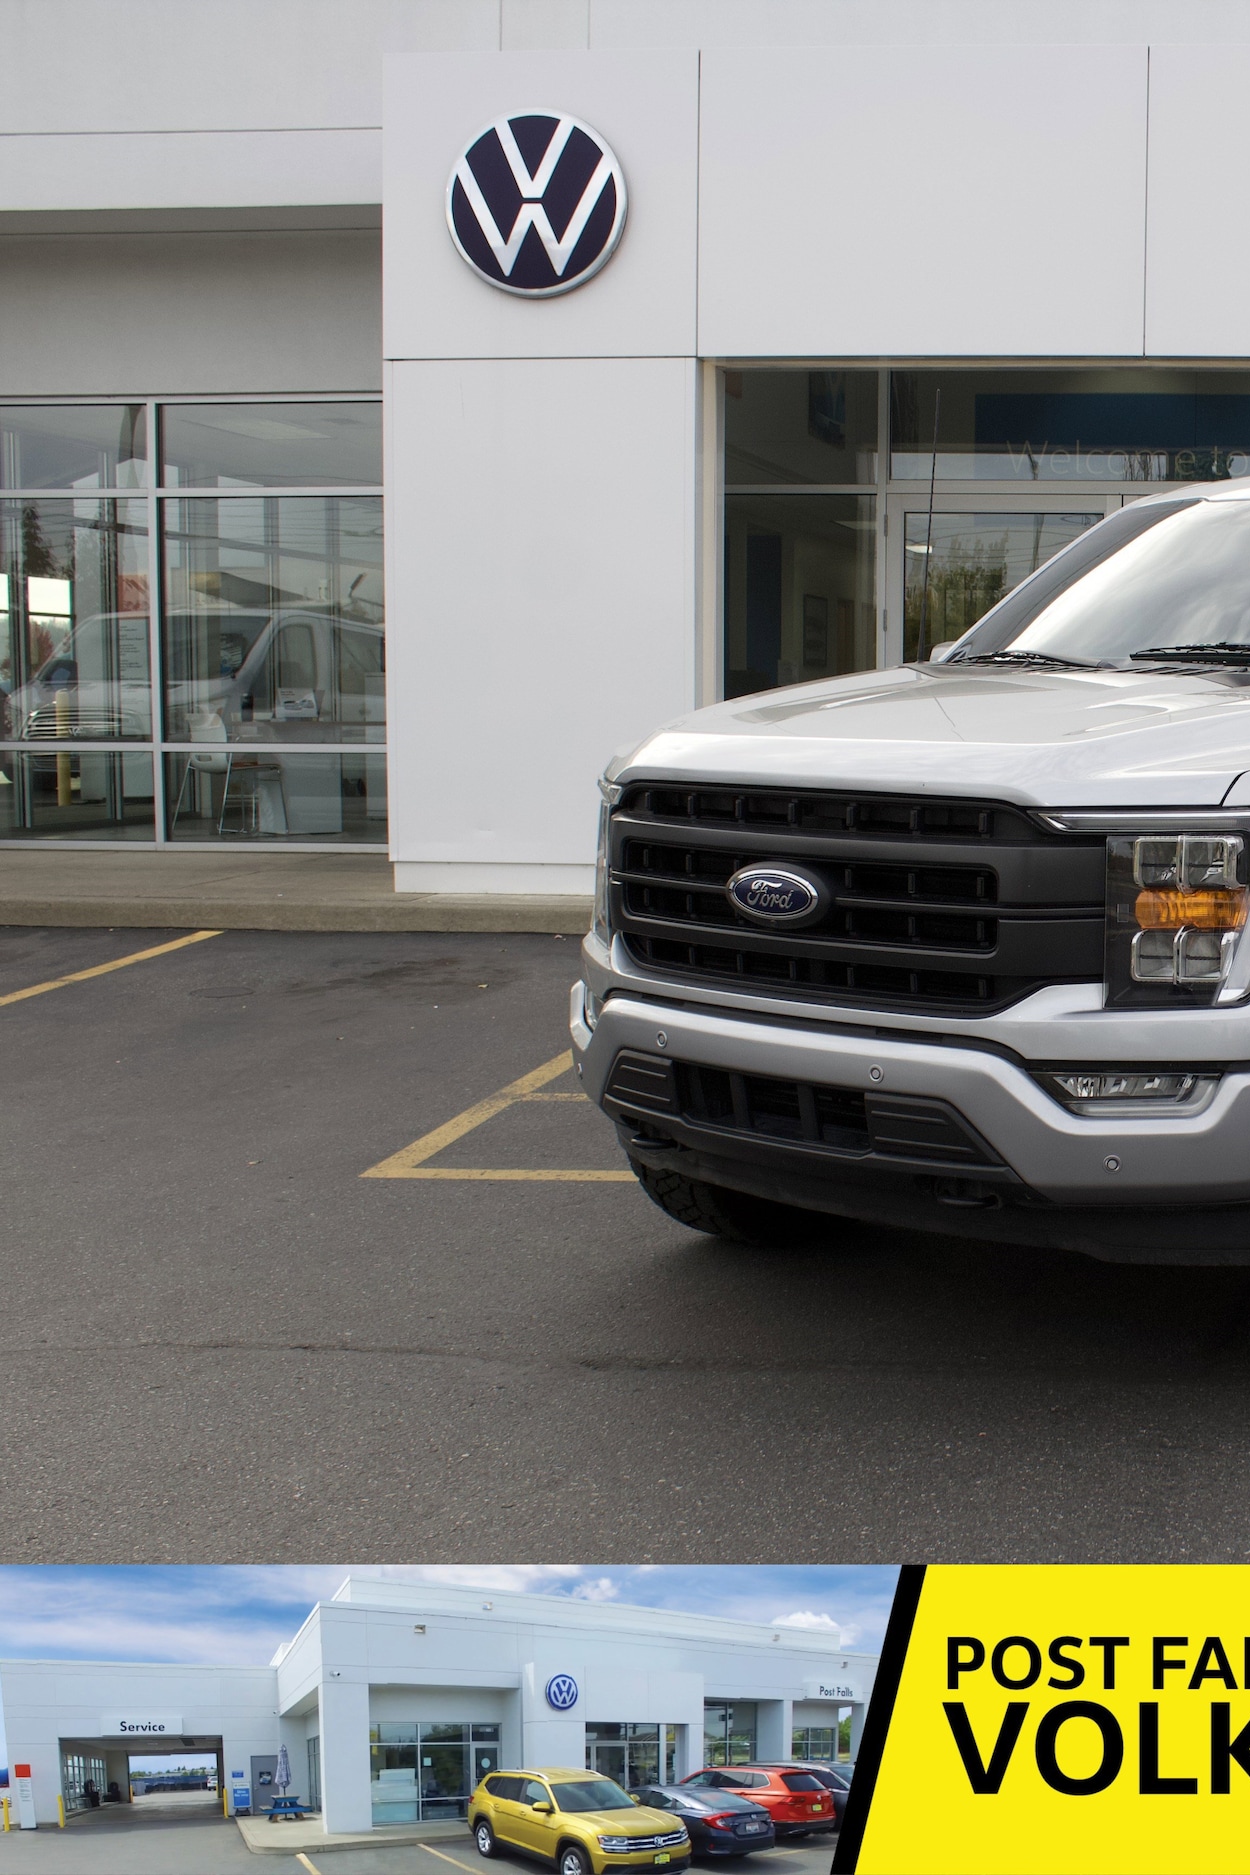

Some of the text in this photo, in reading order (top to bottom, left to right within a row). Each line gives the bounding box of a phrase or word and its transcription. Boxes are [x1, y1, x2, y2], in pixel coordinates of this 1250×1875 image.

[1006, 439, 1197, 476] Welcome
[1210, 445, 1248, 476] to
[746, 879, 795, 909] Ford
